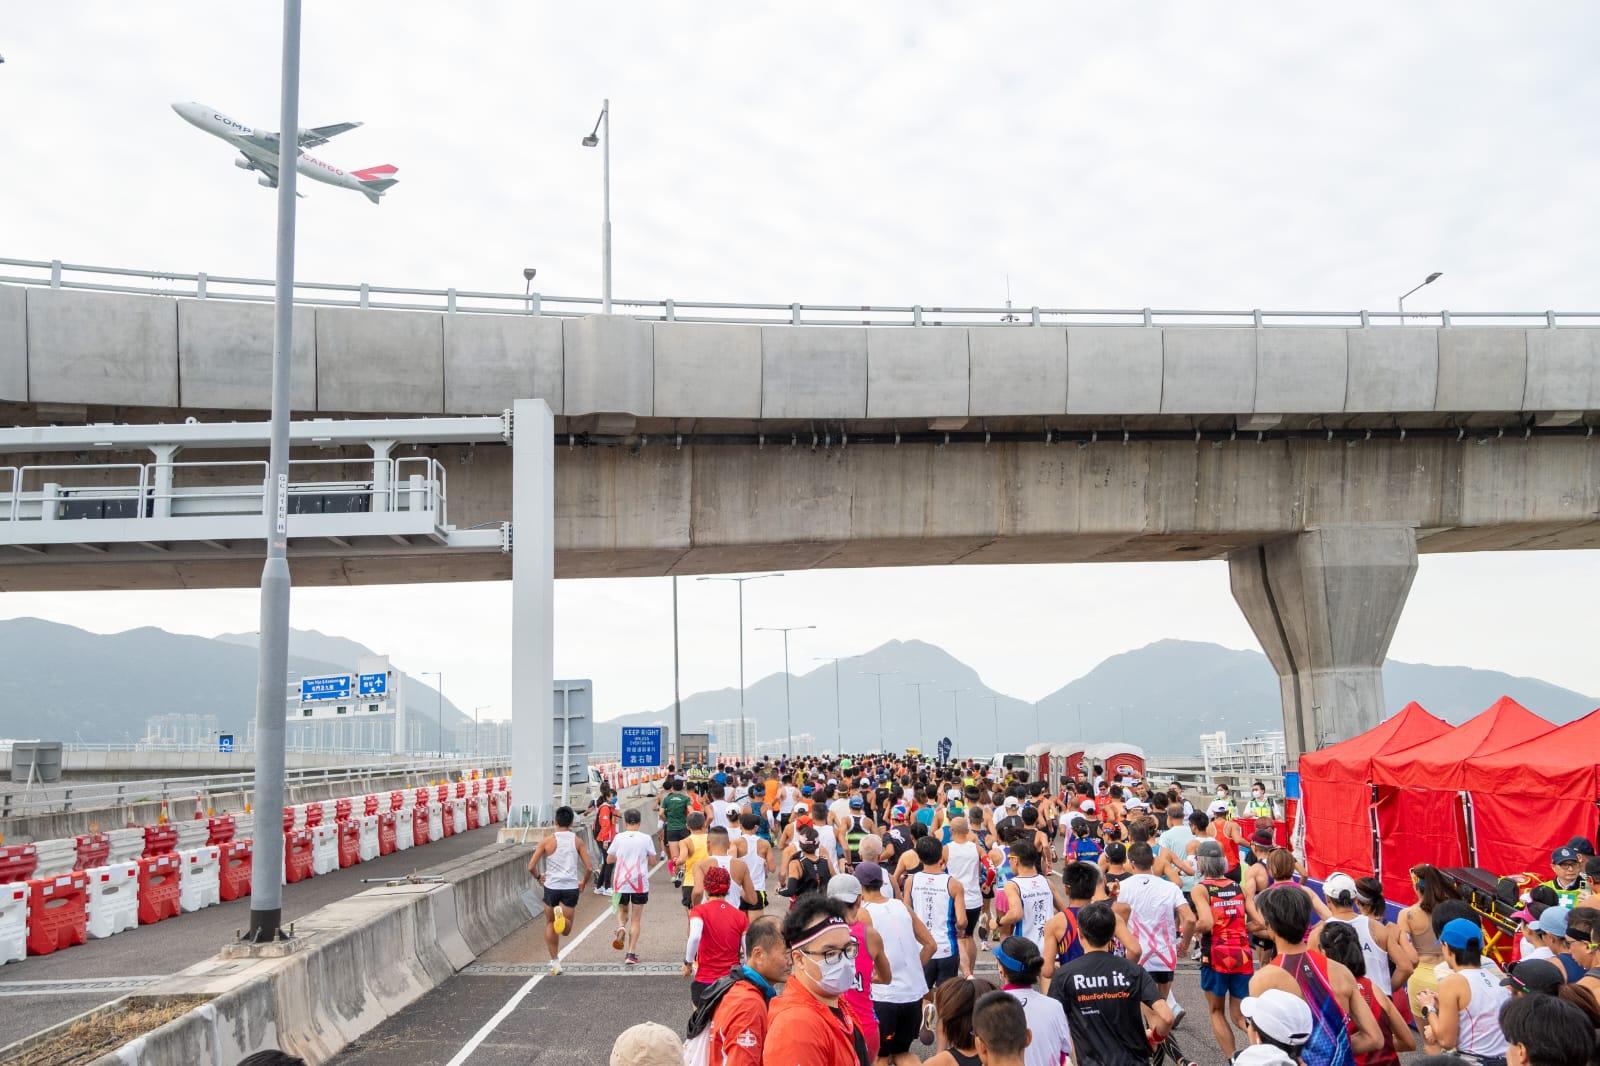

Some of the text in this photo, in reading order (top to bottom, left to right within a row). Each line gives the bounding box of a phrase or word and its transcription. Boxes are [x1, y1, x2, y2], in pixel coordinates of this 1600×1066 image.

[214, 114, 252, 133] COMP
[302, 153, 344, 176] CARGO
[1073, 970, 1131, 990] Run it.
[1077, 991, 1130, 1002] #RunForYourCity
